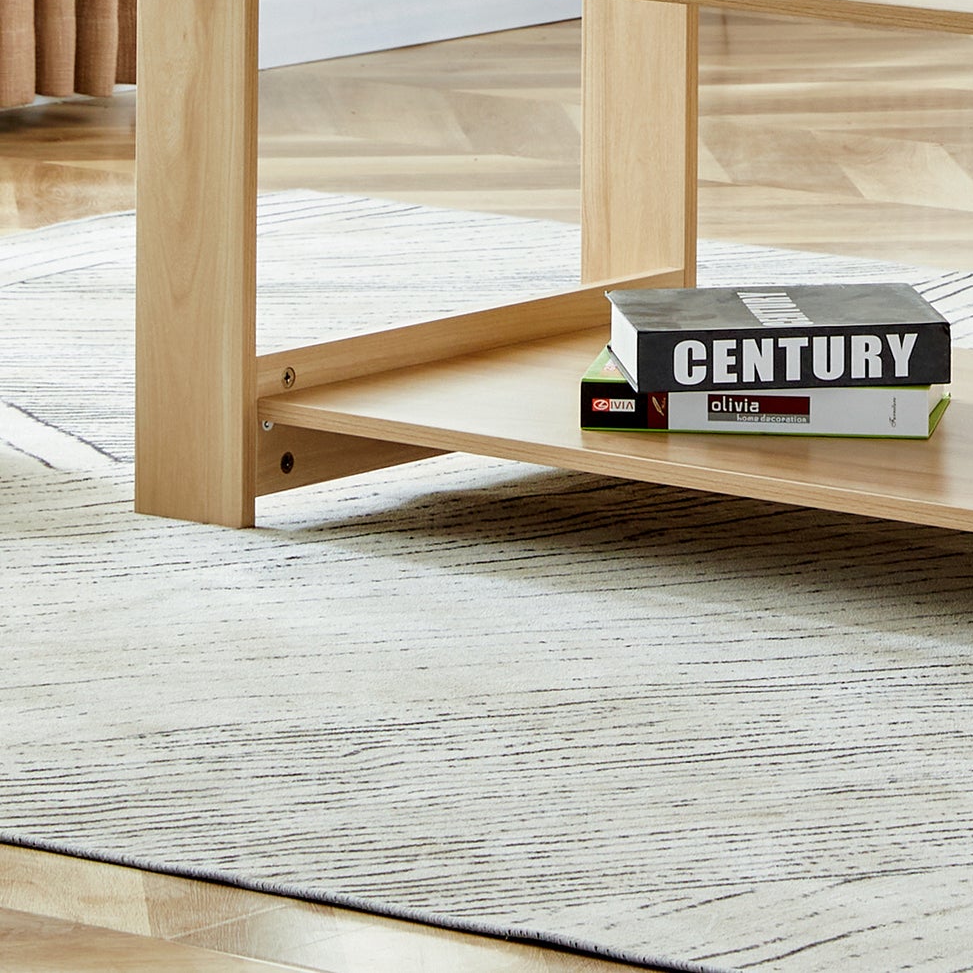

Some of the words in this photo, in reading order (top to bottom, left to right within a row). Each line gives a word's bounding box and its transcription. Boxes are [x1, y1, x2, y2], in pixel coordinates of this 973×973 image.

[673, 333, 918, 386] CENTURY
[711, 395, 760, 413] olivia
[736, 413, 759, 422] home
